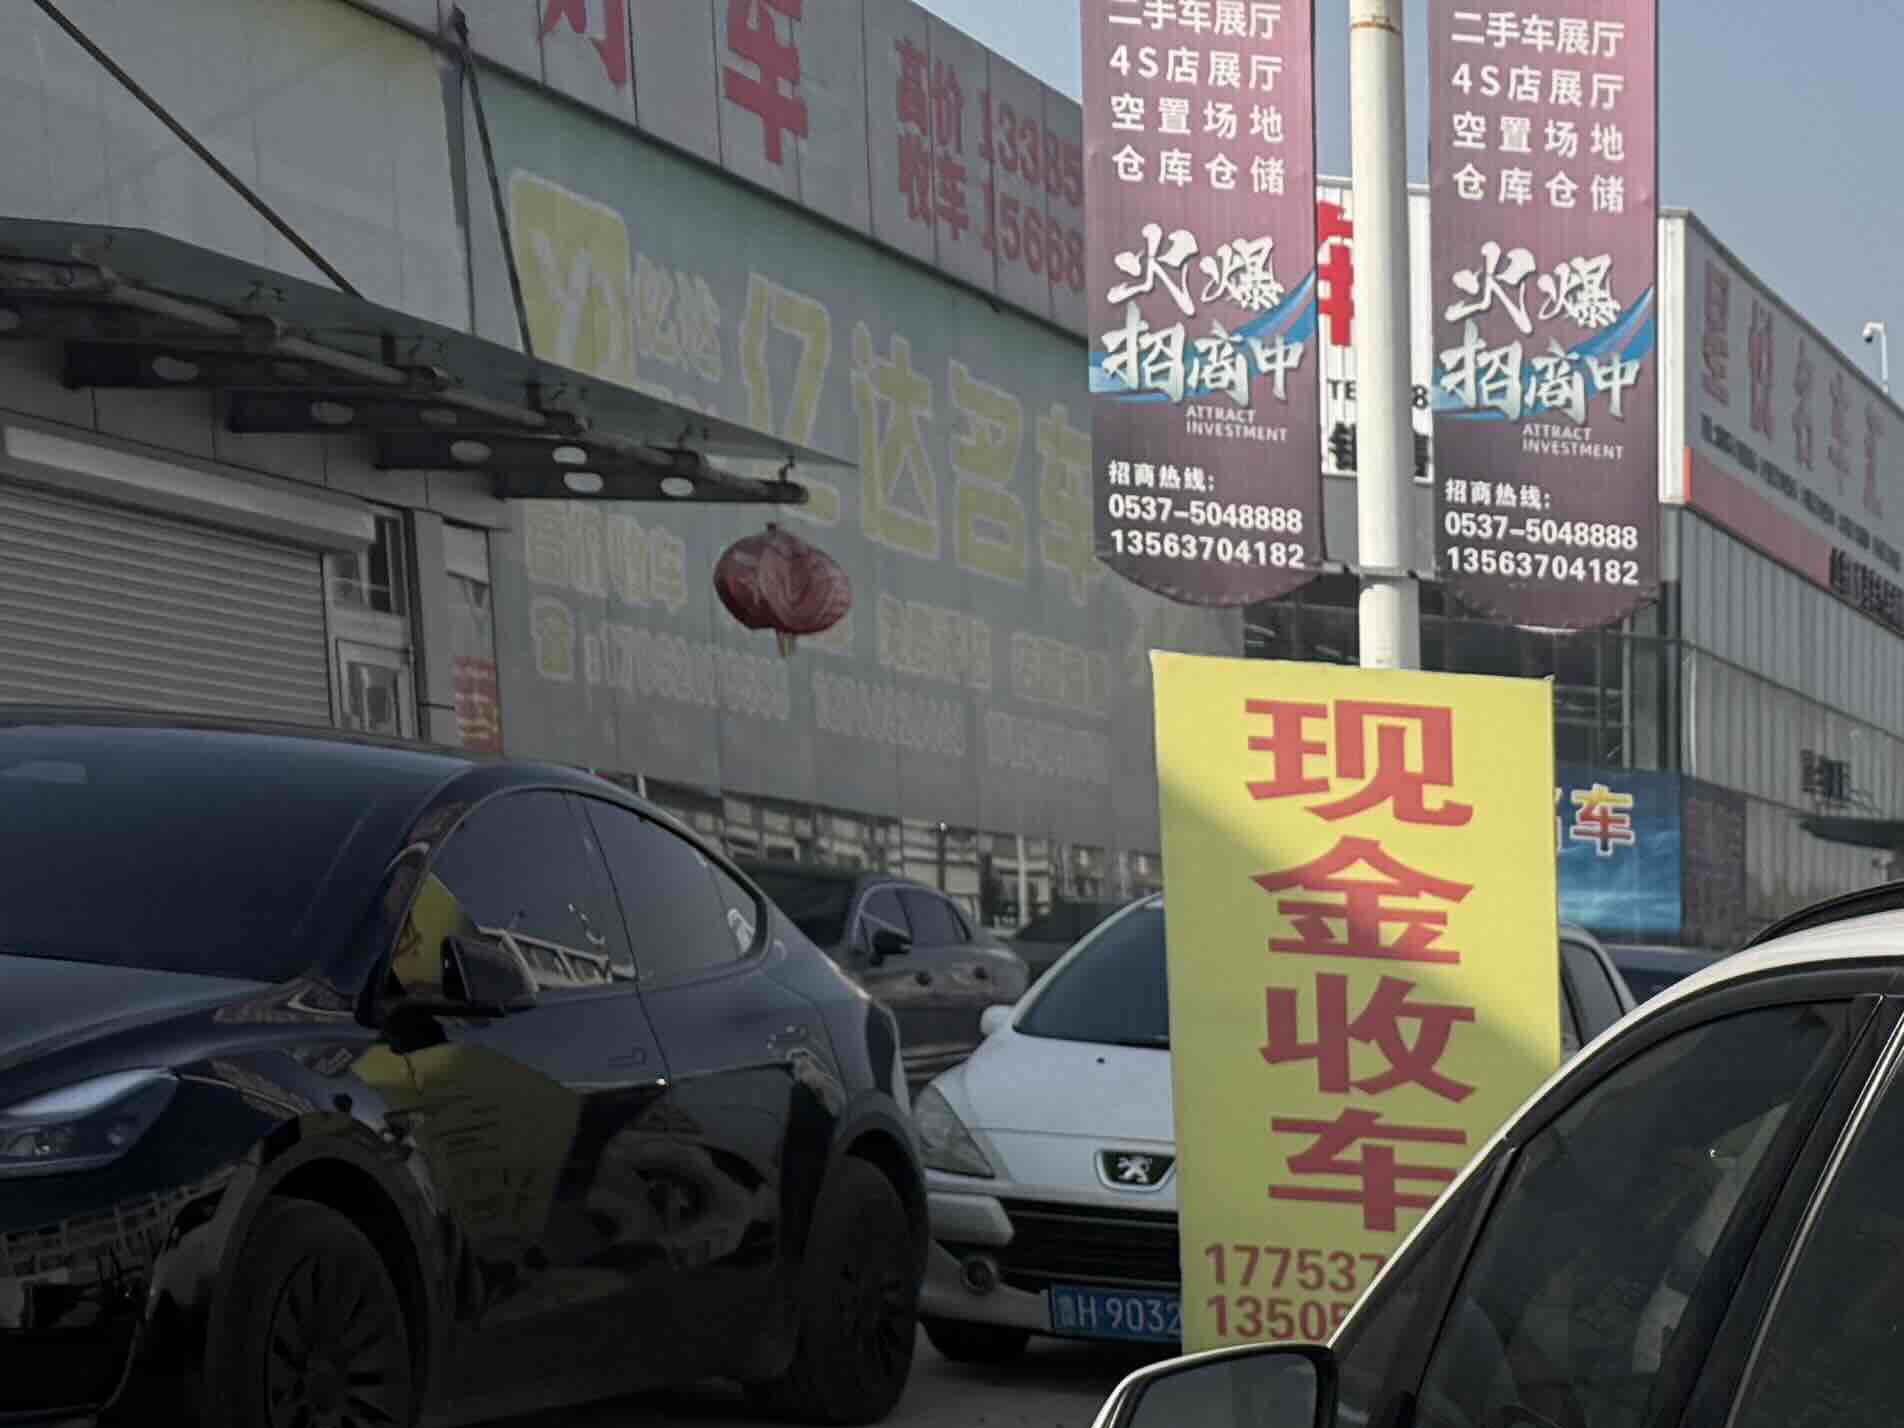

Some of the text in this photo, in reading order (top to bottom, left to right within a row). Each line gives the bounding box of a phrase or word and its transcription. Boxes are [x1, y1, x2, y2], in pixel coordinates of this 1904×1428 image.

[1108, 0, 1281, 41] 二手车展厅
[1451, 11, 1625, 57] 二手车展厅
[1110, 45, 1283, 92] 4S店展厅
[1452, 62, 1625, 112] 4S店展厅
[1111, 94, 1285, 143] 空置场地
[1452, 112, 1625, 161] 空置场地
[1112, 145, 1285, 197] 仓库仓储
[1453, 163, 1625, 213] 仓库仓储
[1107, 223, 1285, 316] 火爆
[1444, 240, 1621, 335] 火爆
[1101, 301, 1304, 405] 招商中
[1438, 319, 1641, 424] 招商中
[1185, 404, 1257, 425] ATTRACT
[1186, 420, 1288, 442] INVESTMENT
[1522, 423, 1592, 443] ATTRACT
[1522, 438, 1624, 461] INVESTMENT
[1108, 493, 1303, 533] 0537-5048888
[1444, 511, 1639, 550] 0537-5048888
[1110, 528, 1304, 569] 13563704182
[1446, 547, 1640, 586] 13563704182
[1243, 697, 1477, 1234] 现金收车
